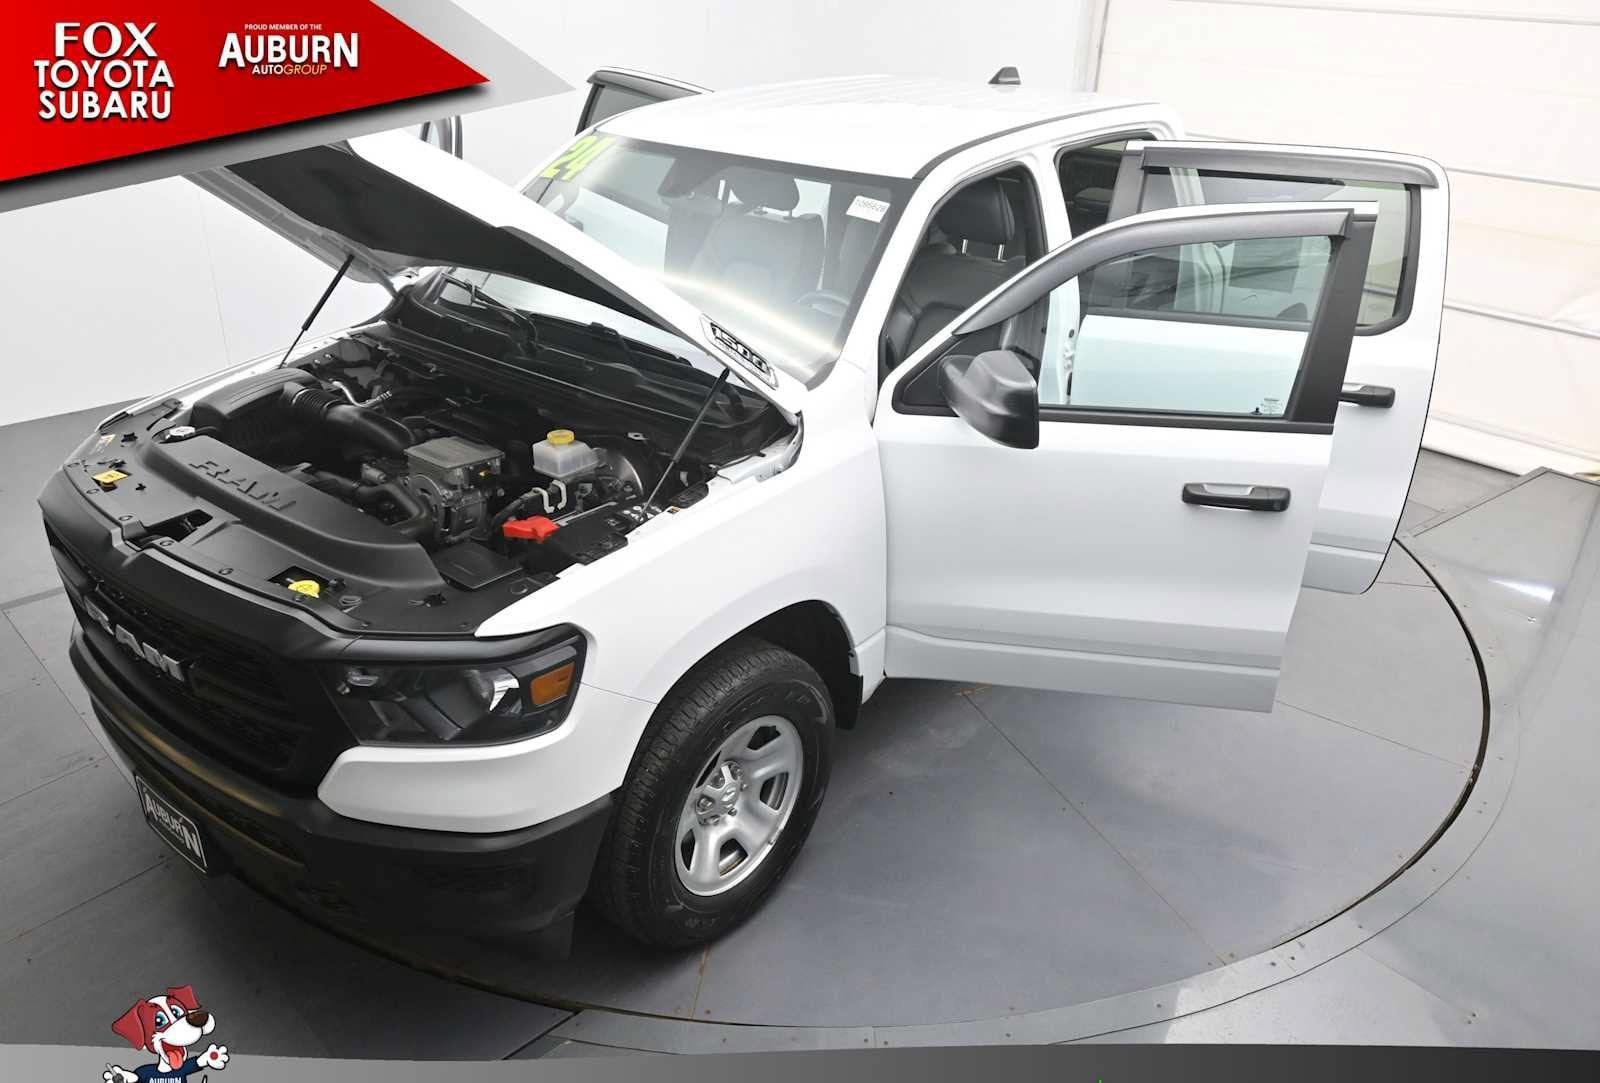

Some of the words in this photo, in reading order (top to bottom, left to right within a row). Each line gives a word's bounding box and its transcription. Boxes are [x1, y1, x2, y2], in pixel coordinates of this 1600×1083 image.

[708, 321, 771, 377] 1500
[188, 460, 297, 511] RAM
[83, 595, 184, 682] RAM
